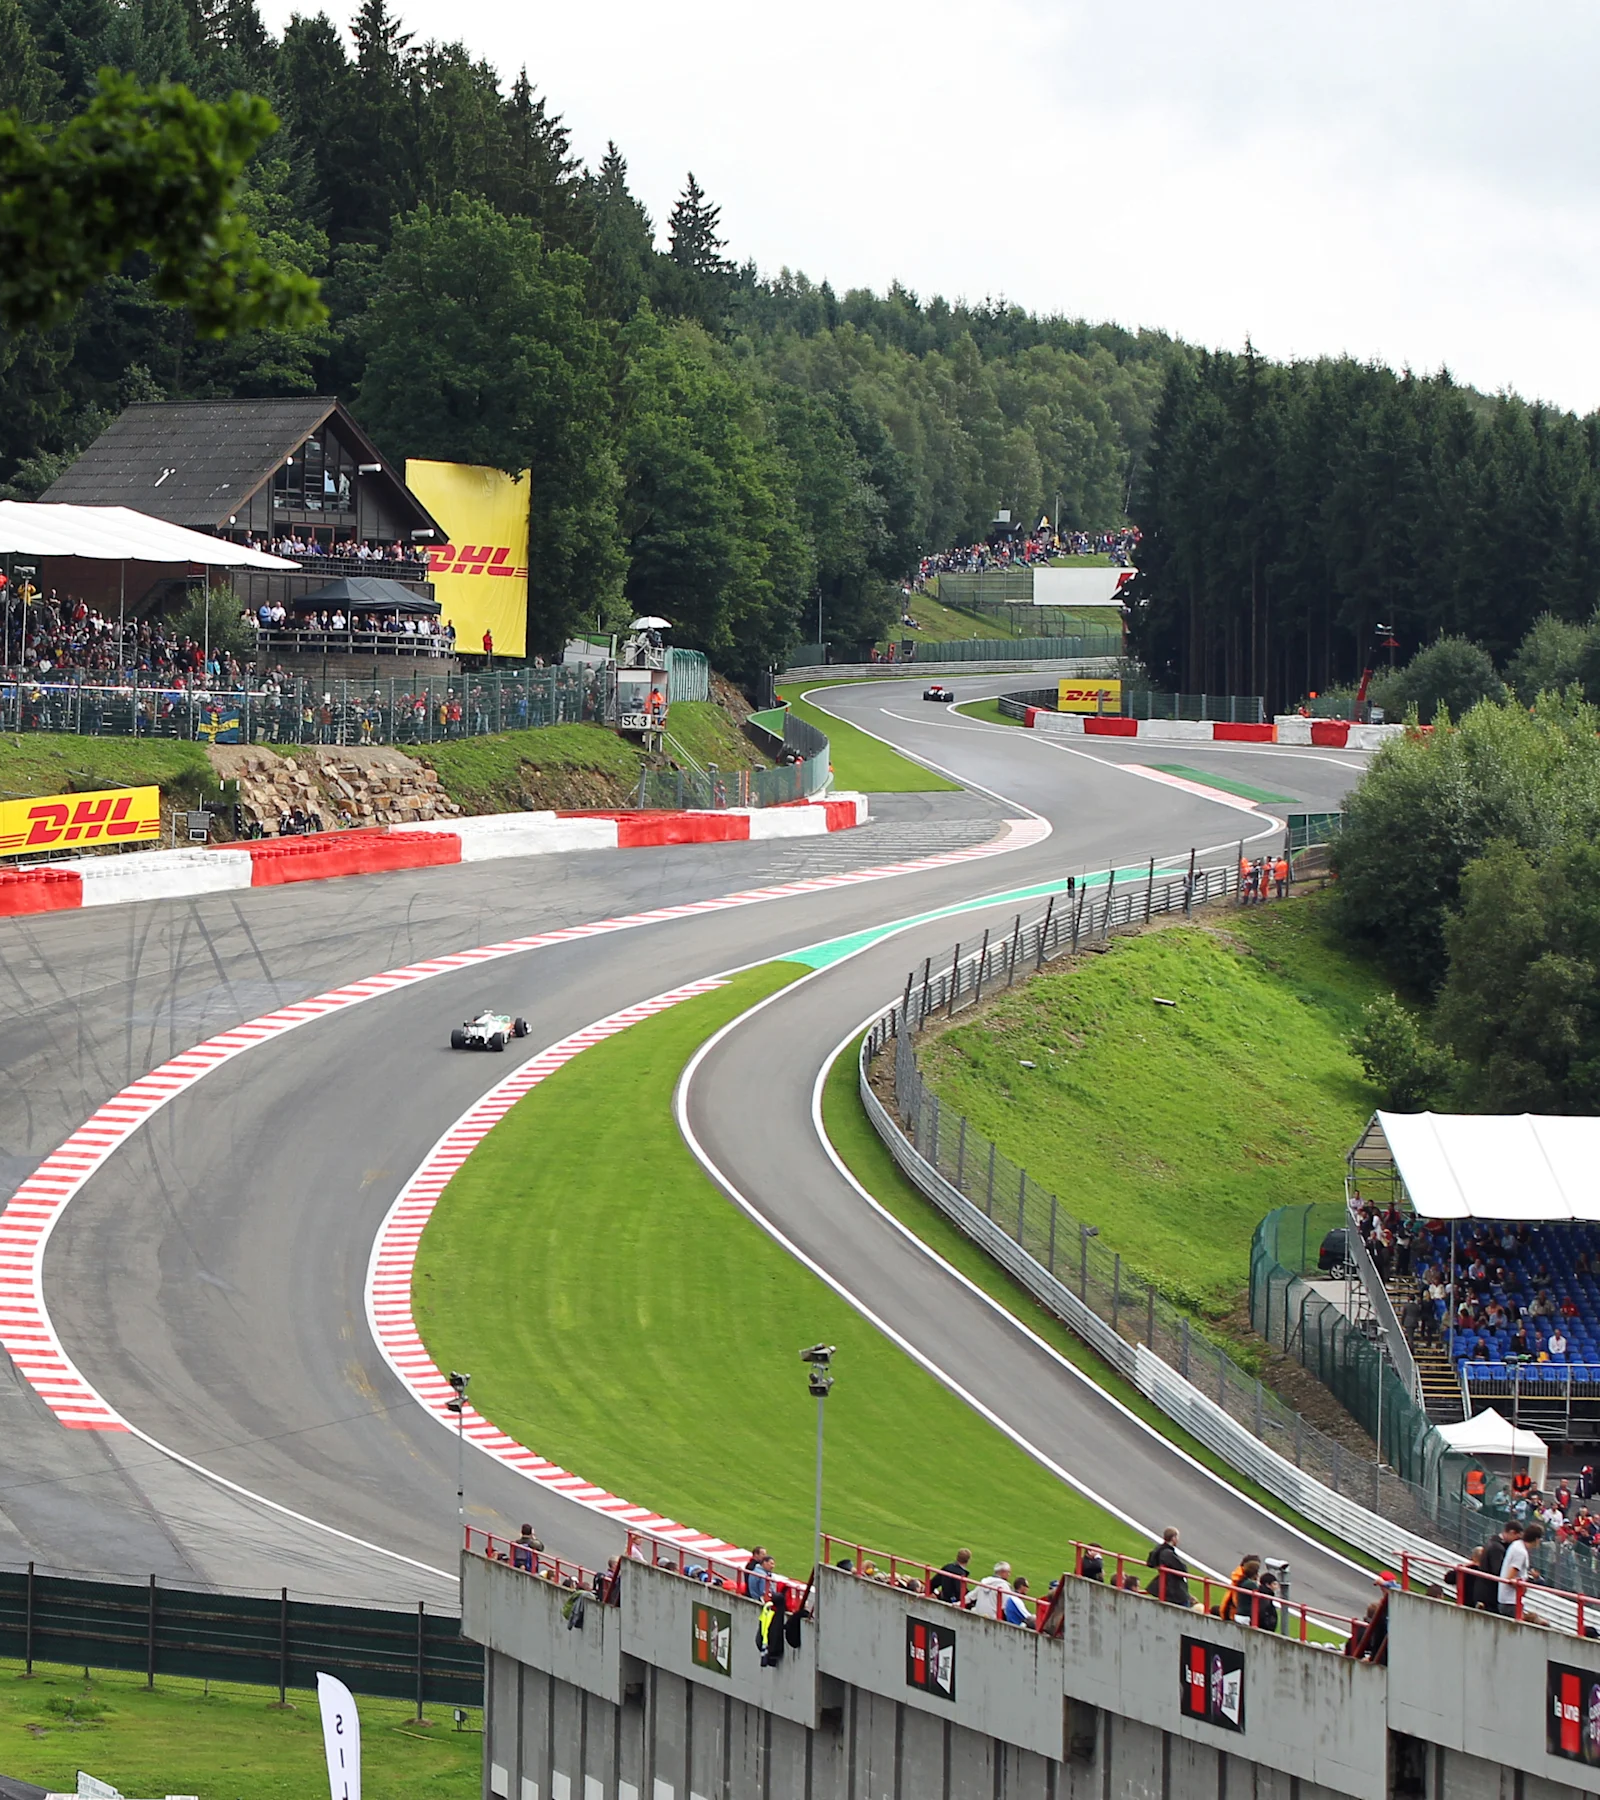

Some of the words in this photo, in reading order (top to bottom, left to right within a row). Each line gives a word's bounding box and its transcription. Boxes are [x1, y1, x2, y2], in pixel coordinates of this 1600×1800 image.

[423, 544, 515, 576] DHL
[1065, 690, 1114, 702] DHL
[25, 797, 140, 846] DHL
[1554, 1695, 1563, 1718] la
[1563, 1703, 1580, 1723] une
